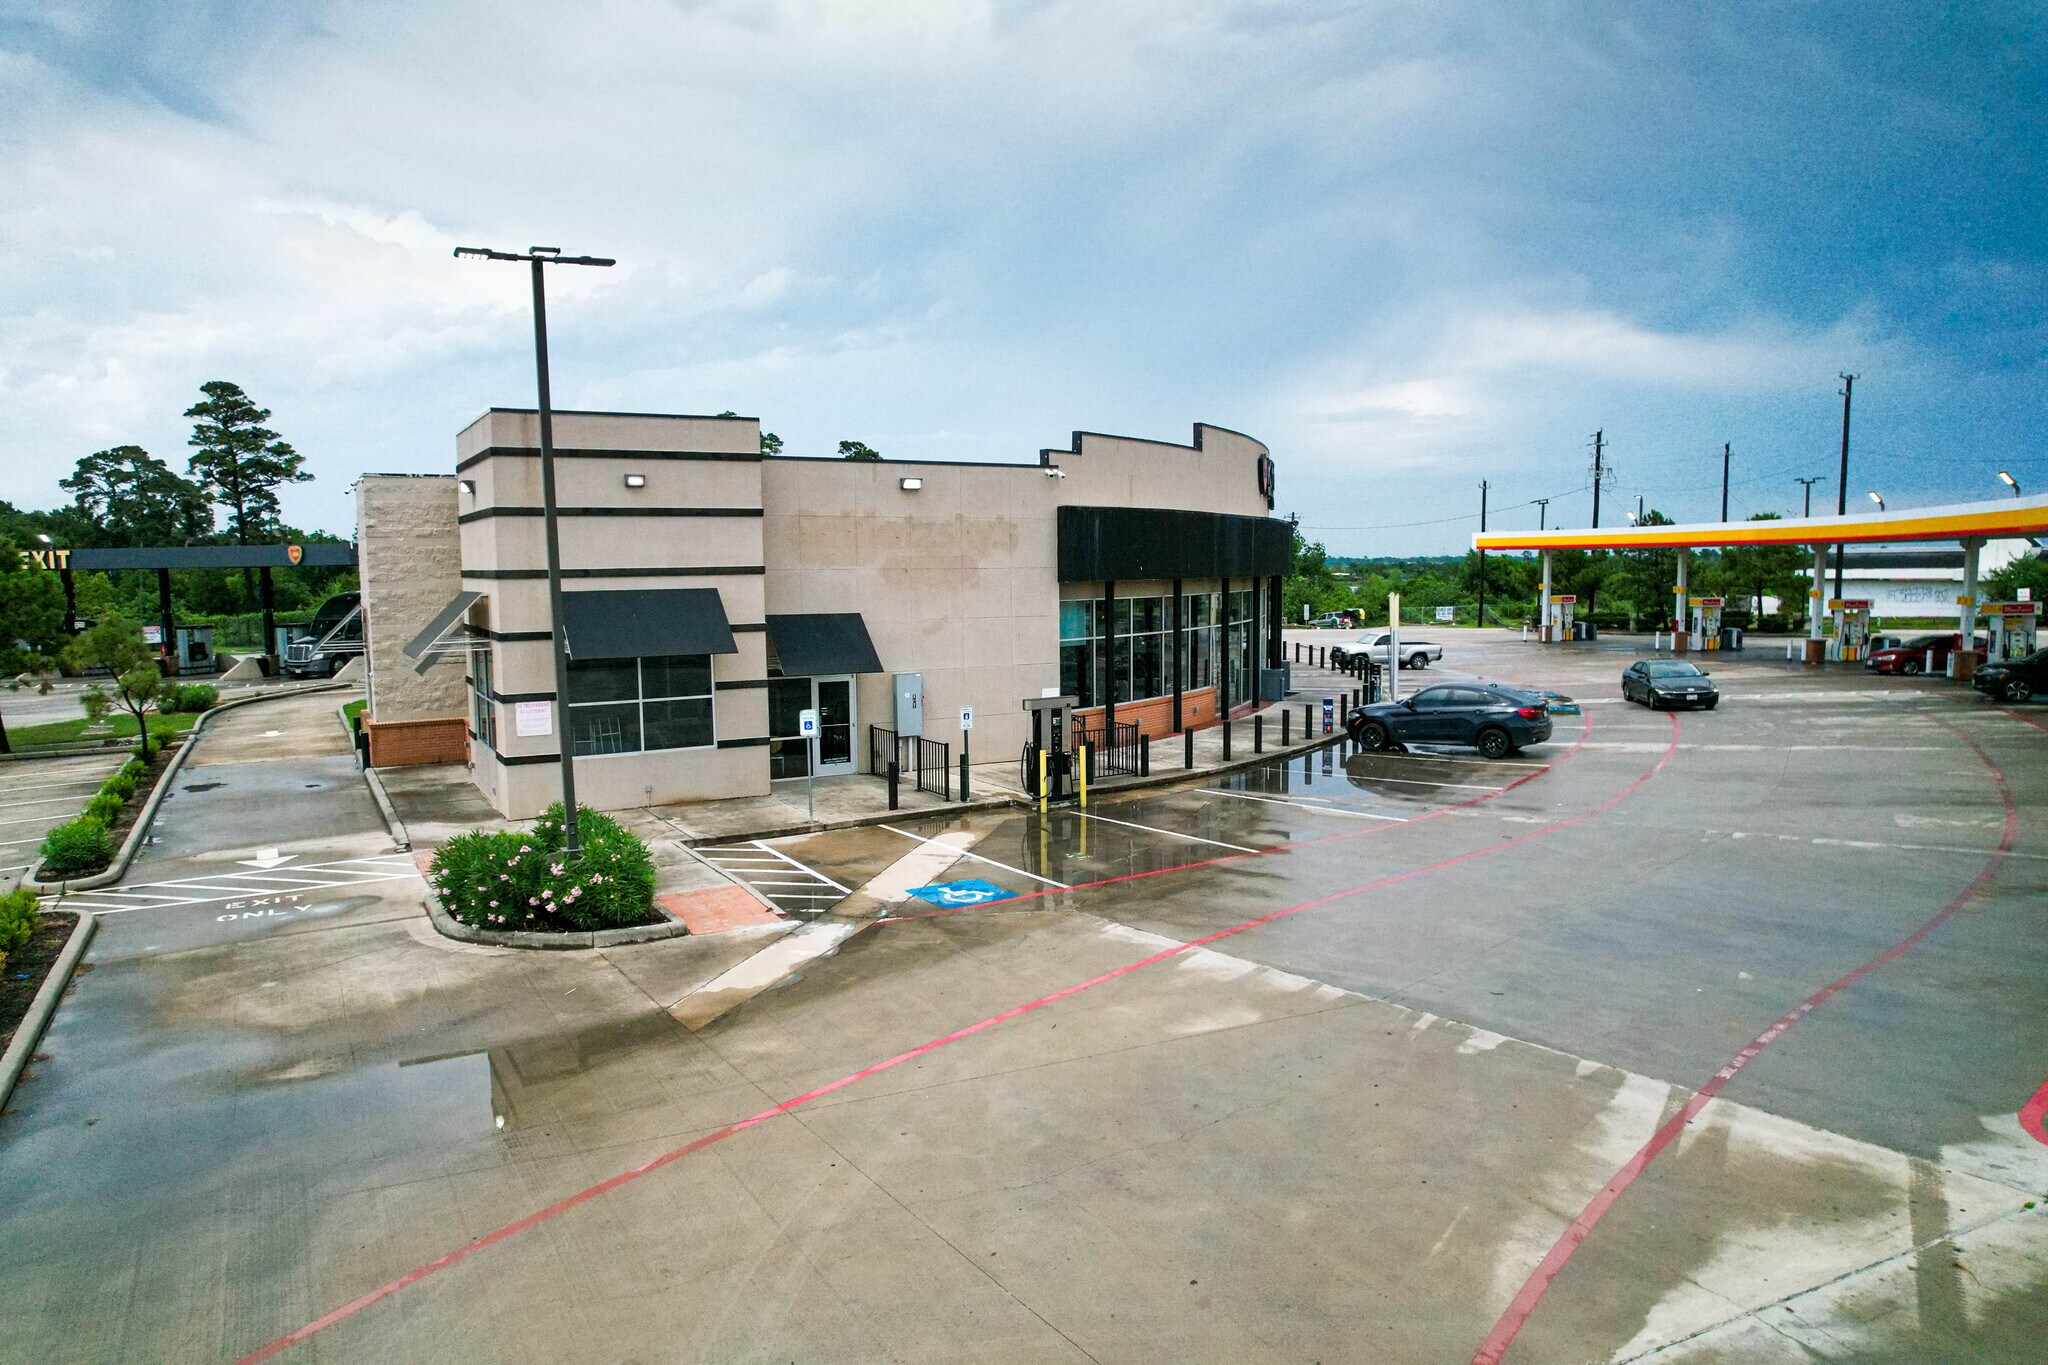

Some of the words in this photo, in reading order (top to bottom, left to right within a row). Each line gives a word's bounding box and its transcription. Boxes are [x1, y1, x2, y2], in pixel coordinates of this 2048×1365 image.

[19, 549, 70, 570] EXIT
[225, 894, 304, 910] EXIT
[216, 904, 312, 921] ONLY
